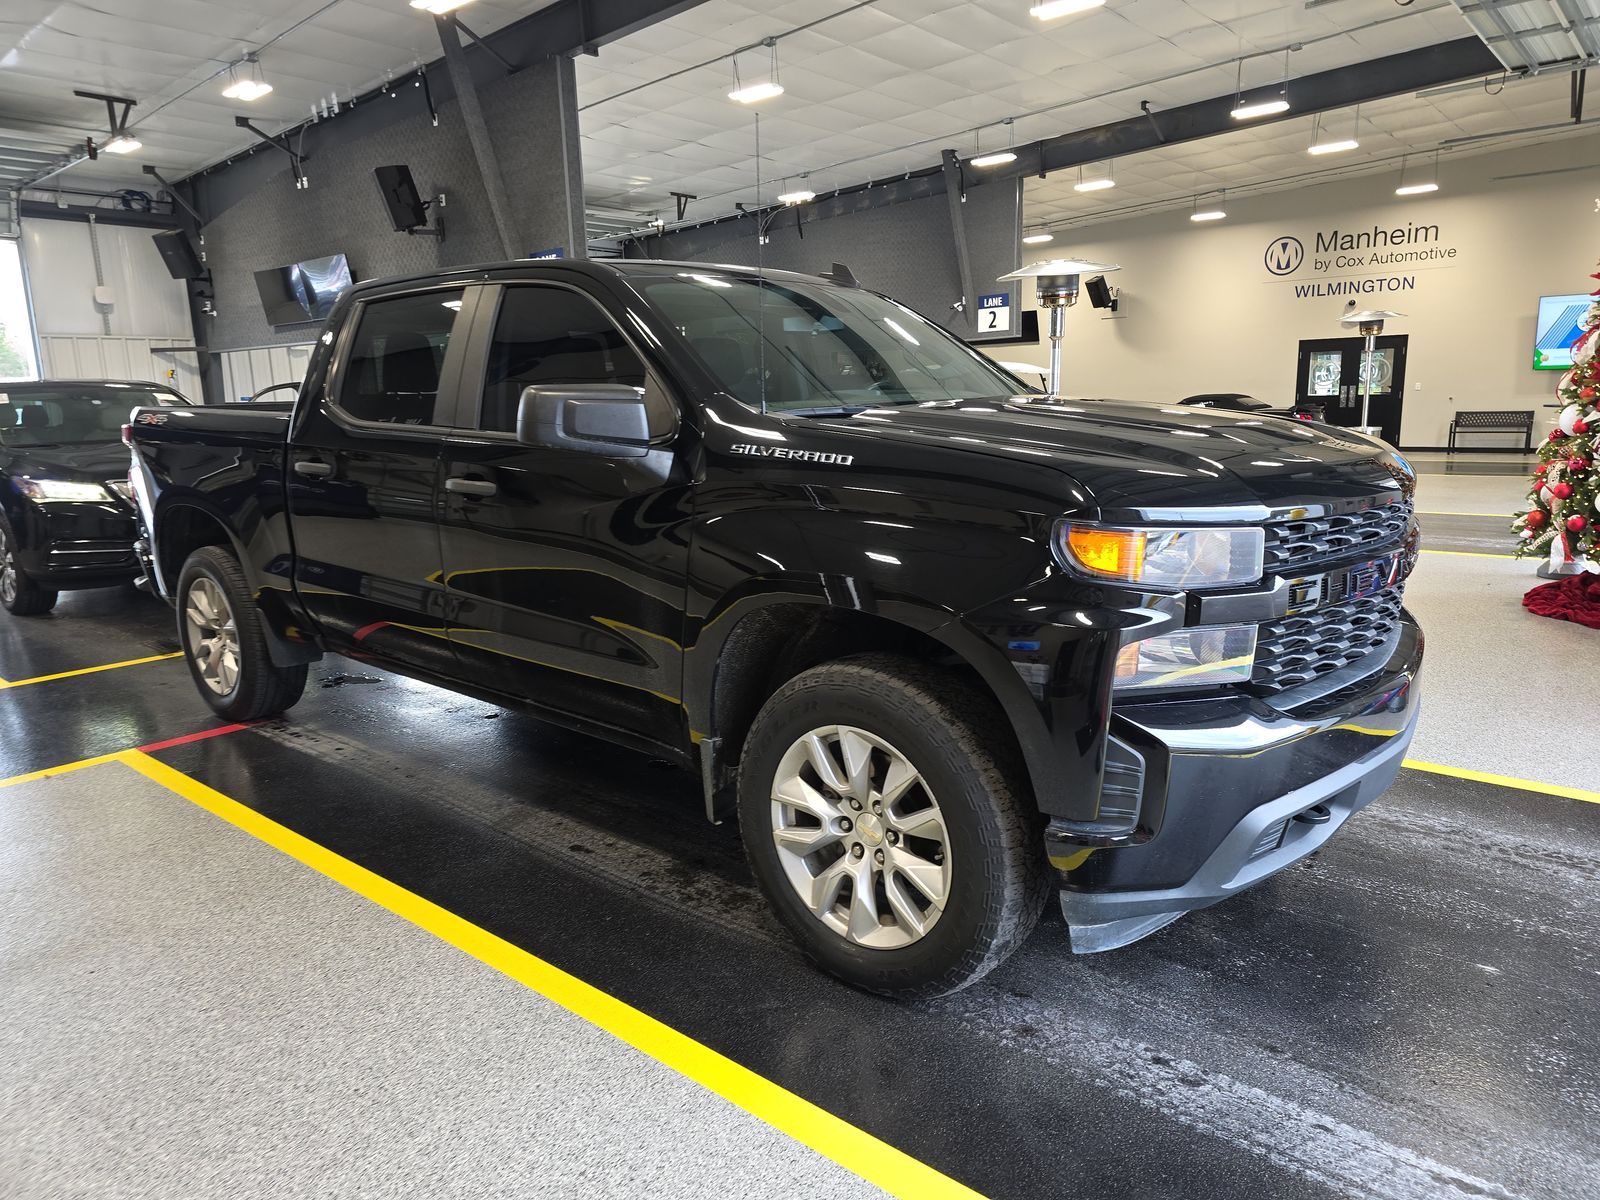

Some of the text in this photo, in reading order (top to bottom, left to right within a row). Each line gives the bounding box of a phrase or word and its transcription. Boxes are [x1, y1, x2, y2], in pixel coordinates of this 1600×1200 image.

[1315, 222, 1439, 253] Manheim
[1314, 246, 1457, 272] by Cox Automotive
[1294, 276, 1415, 298] WILMINGTON
[983, 296, 1003, 308] LANE
[988, 310, 997, 329] 2
[729, 443, 854, 466] SILVERADO
